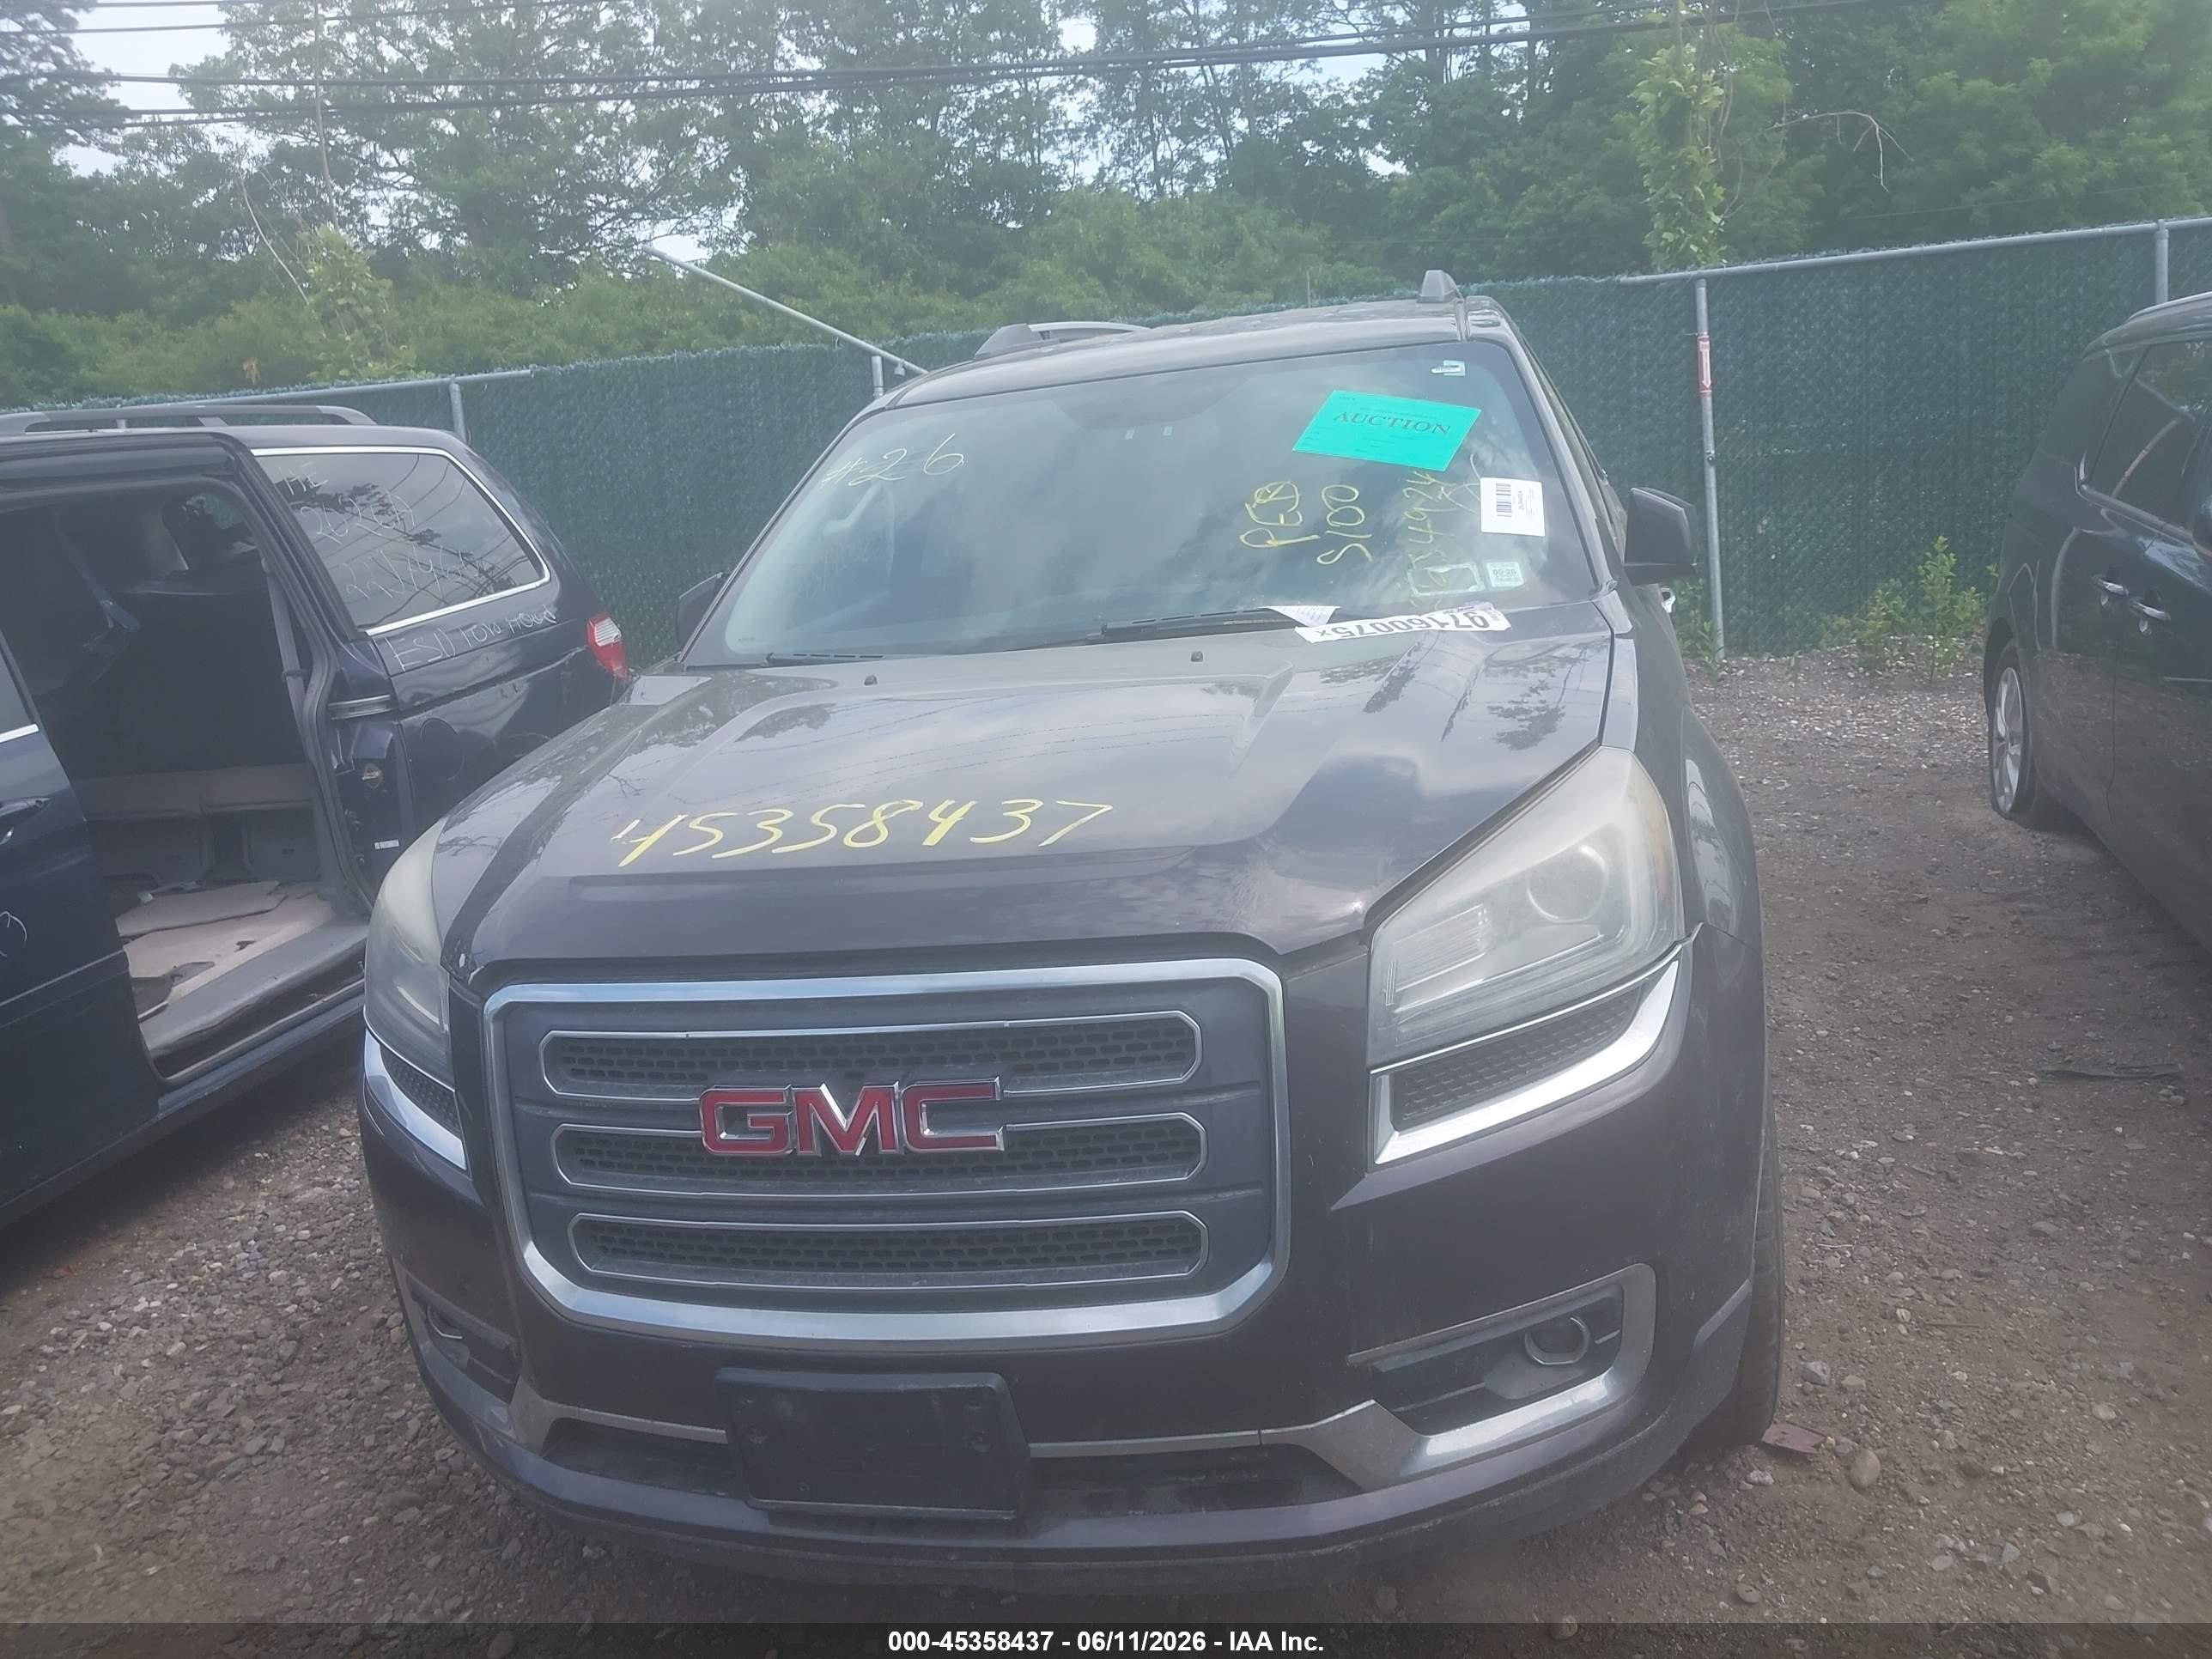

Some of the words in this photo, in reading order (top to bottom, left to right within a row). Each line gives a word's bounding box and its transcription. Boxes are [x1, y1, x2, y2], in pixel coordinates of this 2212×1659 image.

[1334, 411, 1451, 434] AUCTION
[611, 799, 1114, 868] 45358437
[699, 1075, 1006, 1157] GMC
